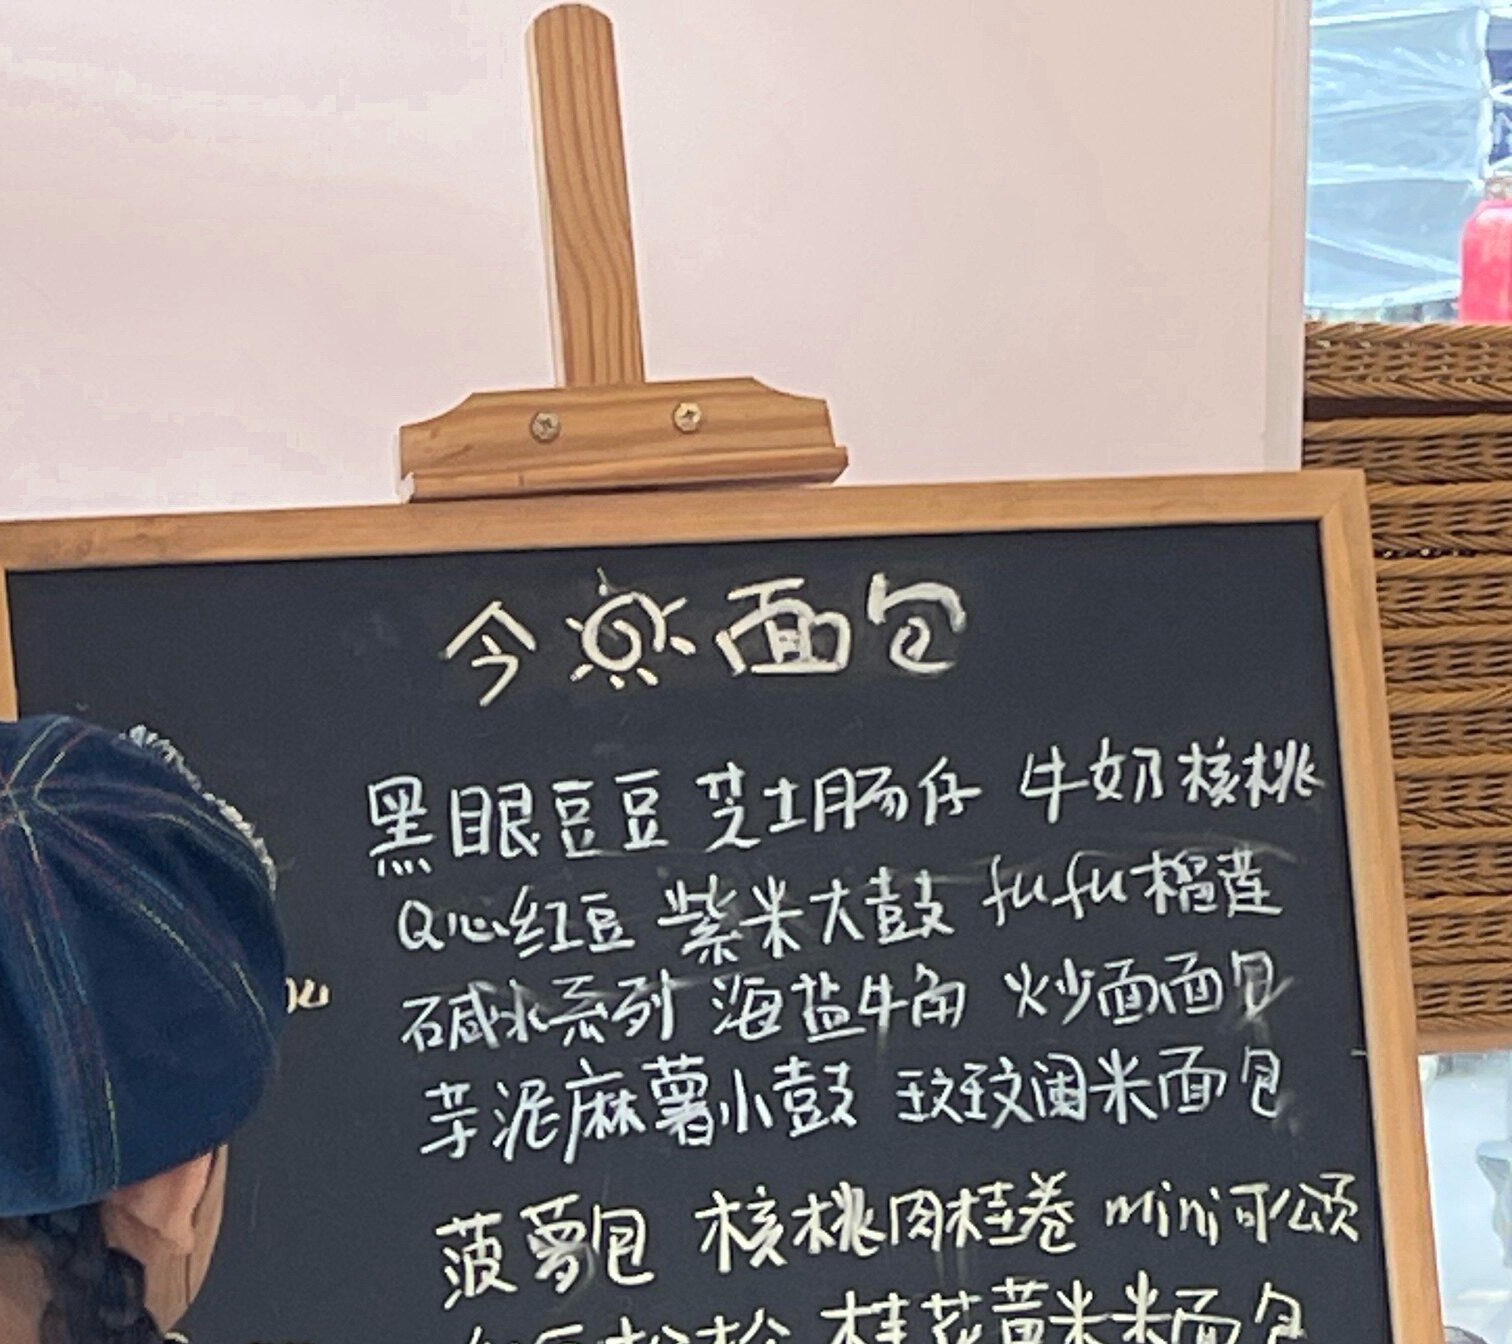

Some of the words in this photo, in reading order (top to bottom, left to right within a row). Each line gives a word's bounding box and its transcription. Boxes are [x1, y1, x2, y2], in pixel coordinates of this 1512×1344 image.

[367, 769, 668, 876] 黑眼豆豆
[696, 758, 982, 852] 芝士肠仔
[1020, 735, 1326, 823] 牛奶核桃
[657, 867, 954, 963] 紫米大鼓
[401, 968, 674, 1053] 碱水系列
[710, 963, 965, 1043] 海盐牛角
[420, 1053, 859, 1165] 芋泥麻薯小鼓
